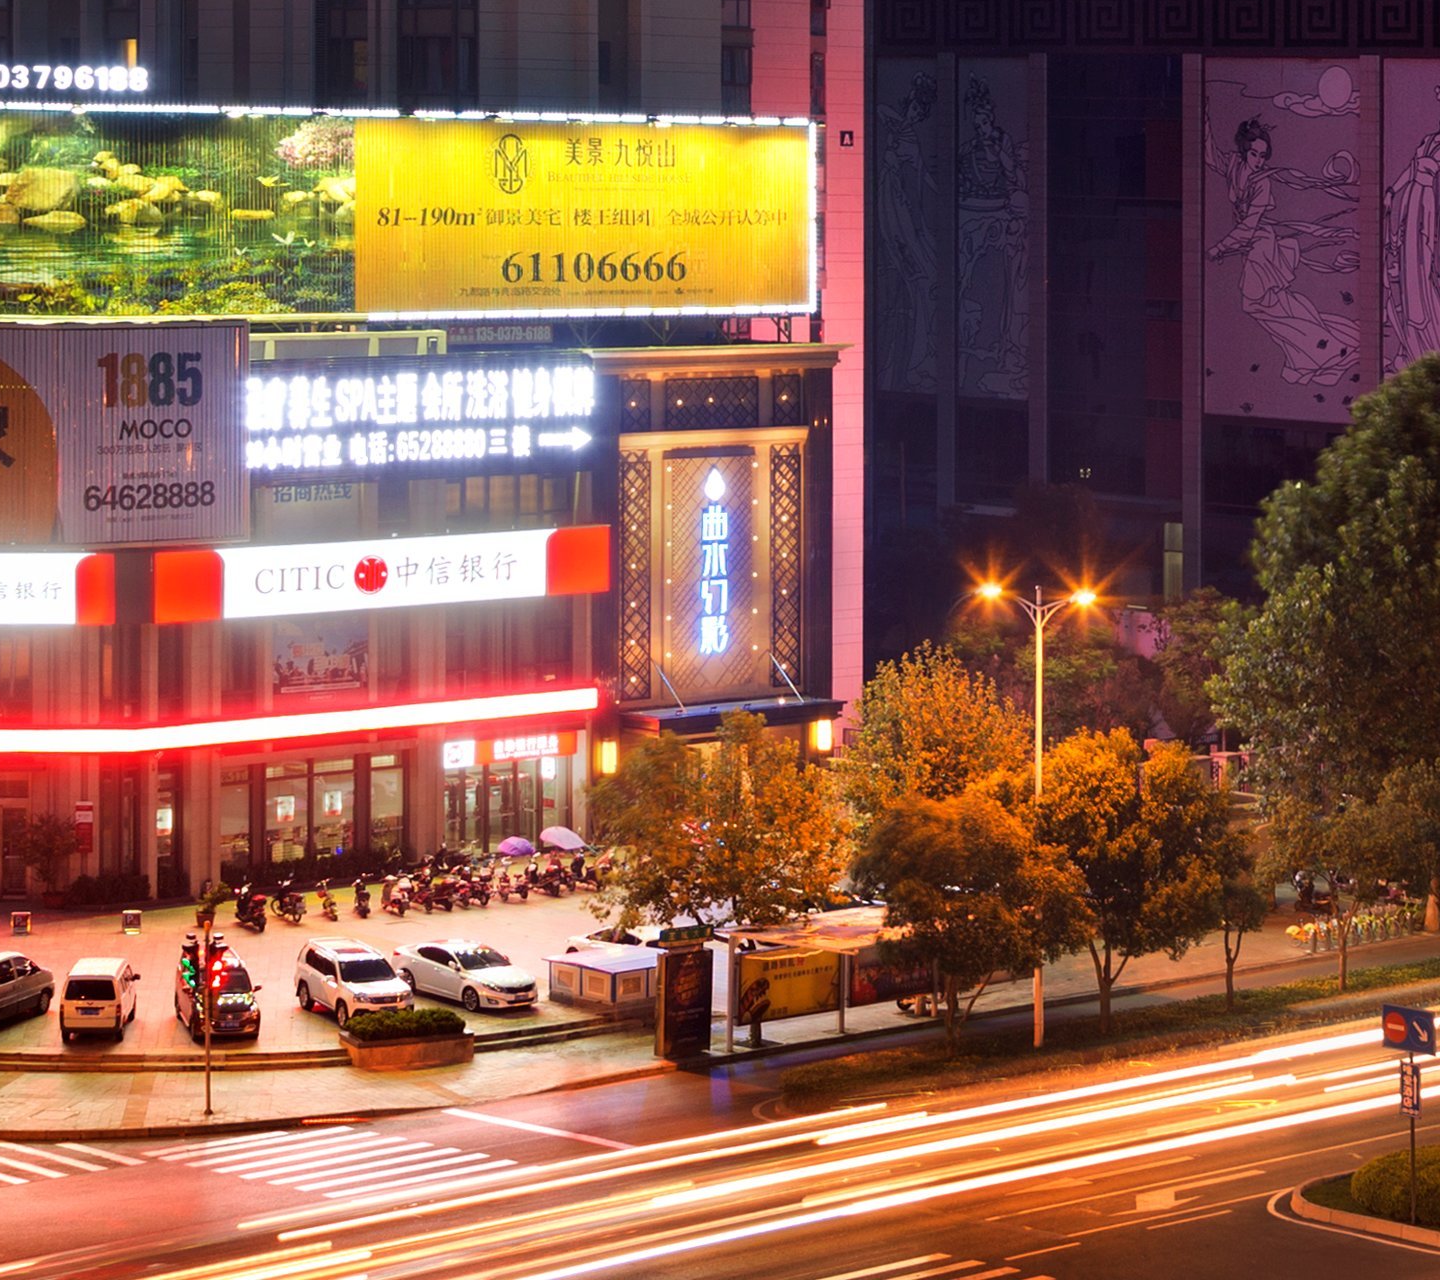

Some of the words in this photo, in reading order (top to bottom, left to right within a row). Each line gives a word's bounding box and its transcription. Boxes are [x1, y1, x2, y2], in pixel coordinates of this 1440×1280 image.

[501, 250, 688, 283] 61106666
[97, 351, 204, 409] 1885
[119, 418, 193, 441] MOCO
[84, 480, 216, 512] 64628888
[254, 562, 346, 596] CITIC
[395, 549, 519, 591] 中信银行
[699, 504, 729, 656] 曲水幻影
